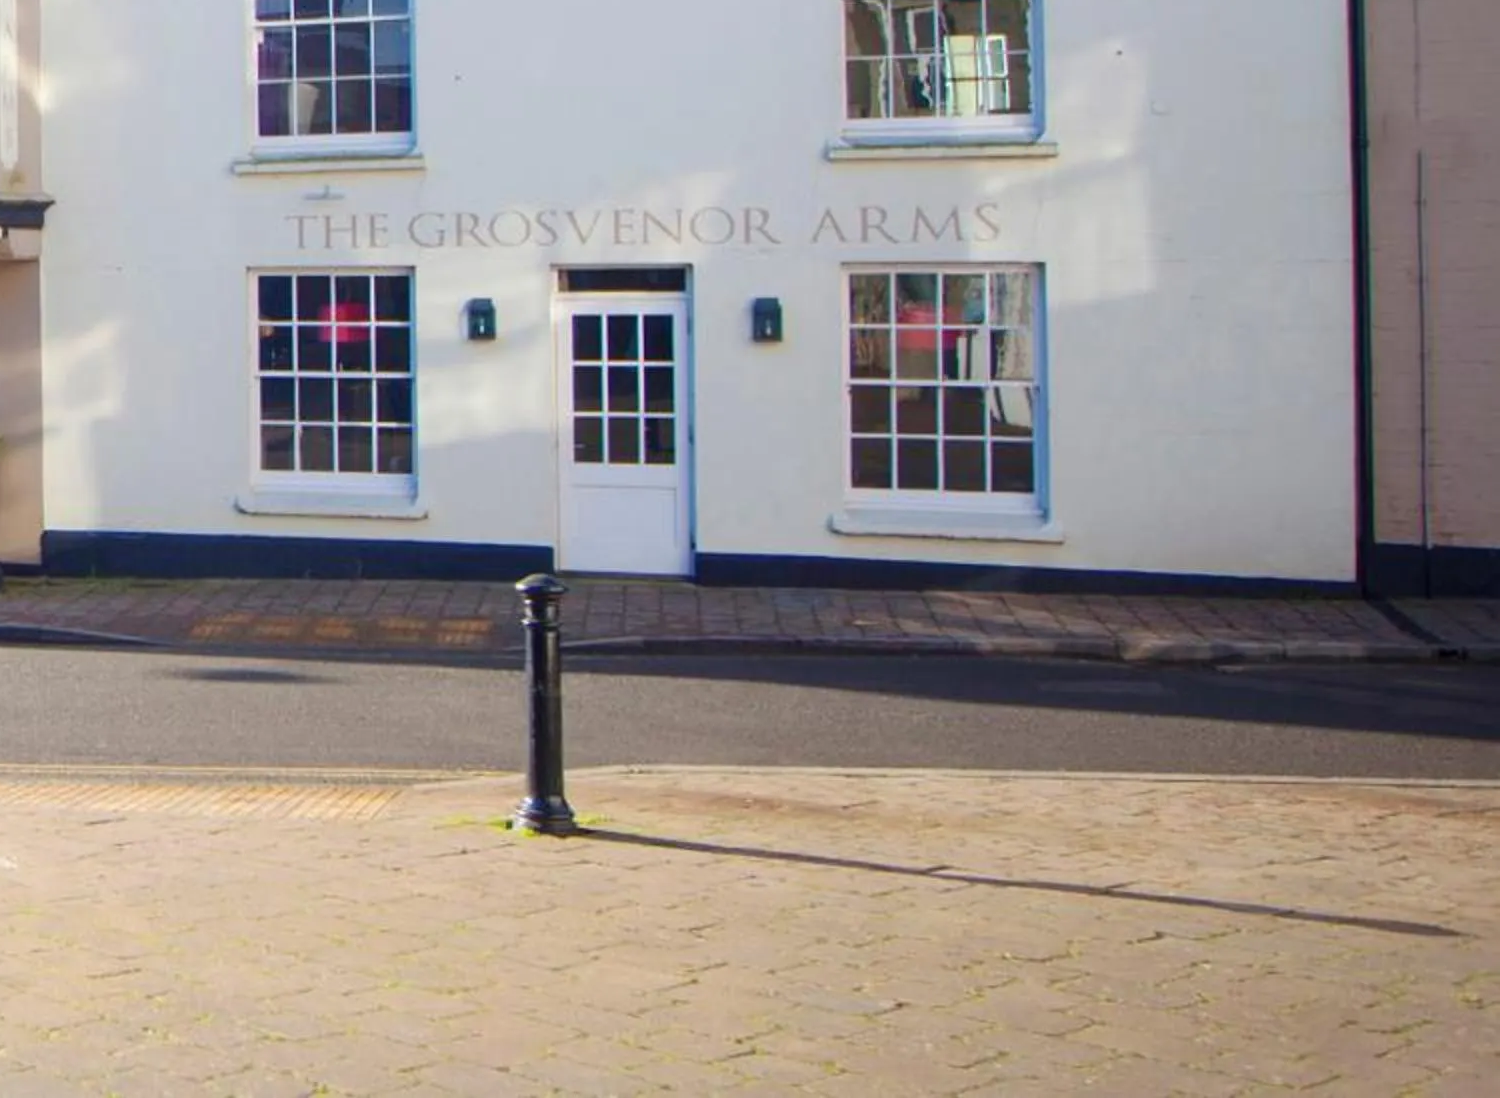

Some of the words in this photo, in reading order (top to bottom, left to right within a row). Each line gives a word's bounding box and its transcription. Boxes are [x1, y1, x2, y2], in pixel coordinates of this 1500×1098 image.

[285, 211, 390, 251] THE
[408, 205, 783, 250] GROSVENOR
[810, 202, 1003, 246] ARMS
